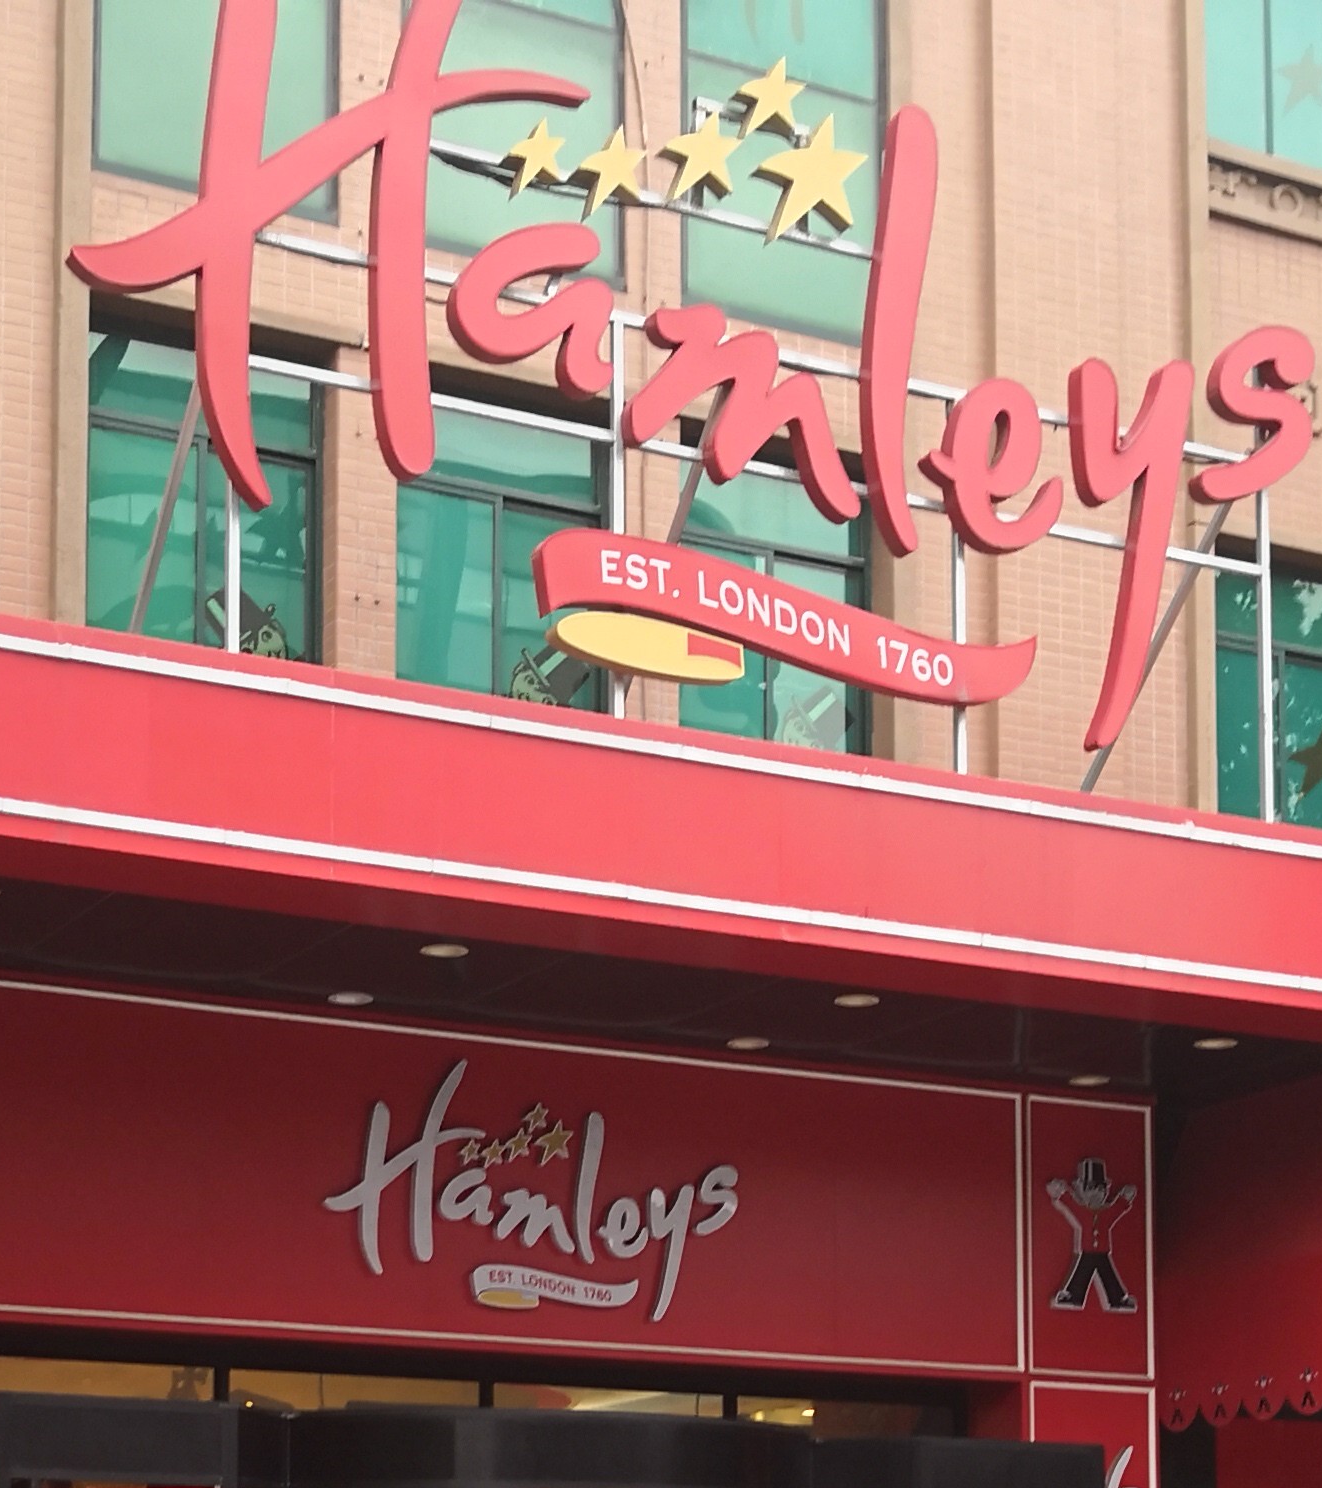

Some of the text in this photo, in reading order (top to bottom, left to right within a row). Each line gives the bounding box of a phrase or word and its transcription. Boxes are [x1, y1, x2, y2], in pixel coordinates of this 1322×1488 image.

[67, 0, 1318, 752] Hamleys
[599, 548, 956, 687] EST. LONDON 1760
[323, 1058, 740, 1322] Hamleys
[521, 1274, 576, 1296] LONDON
